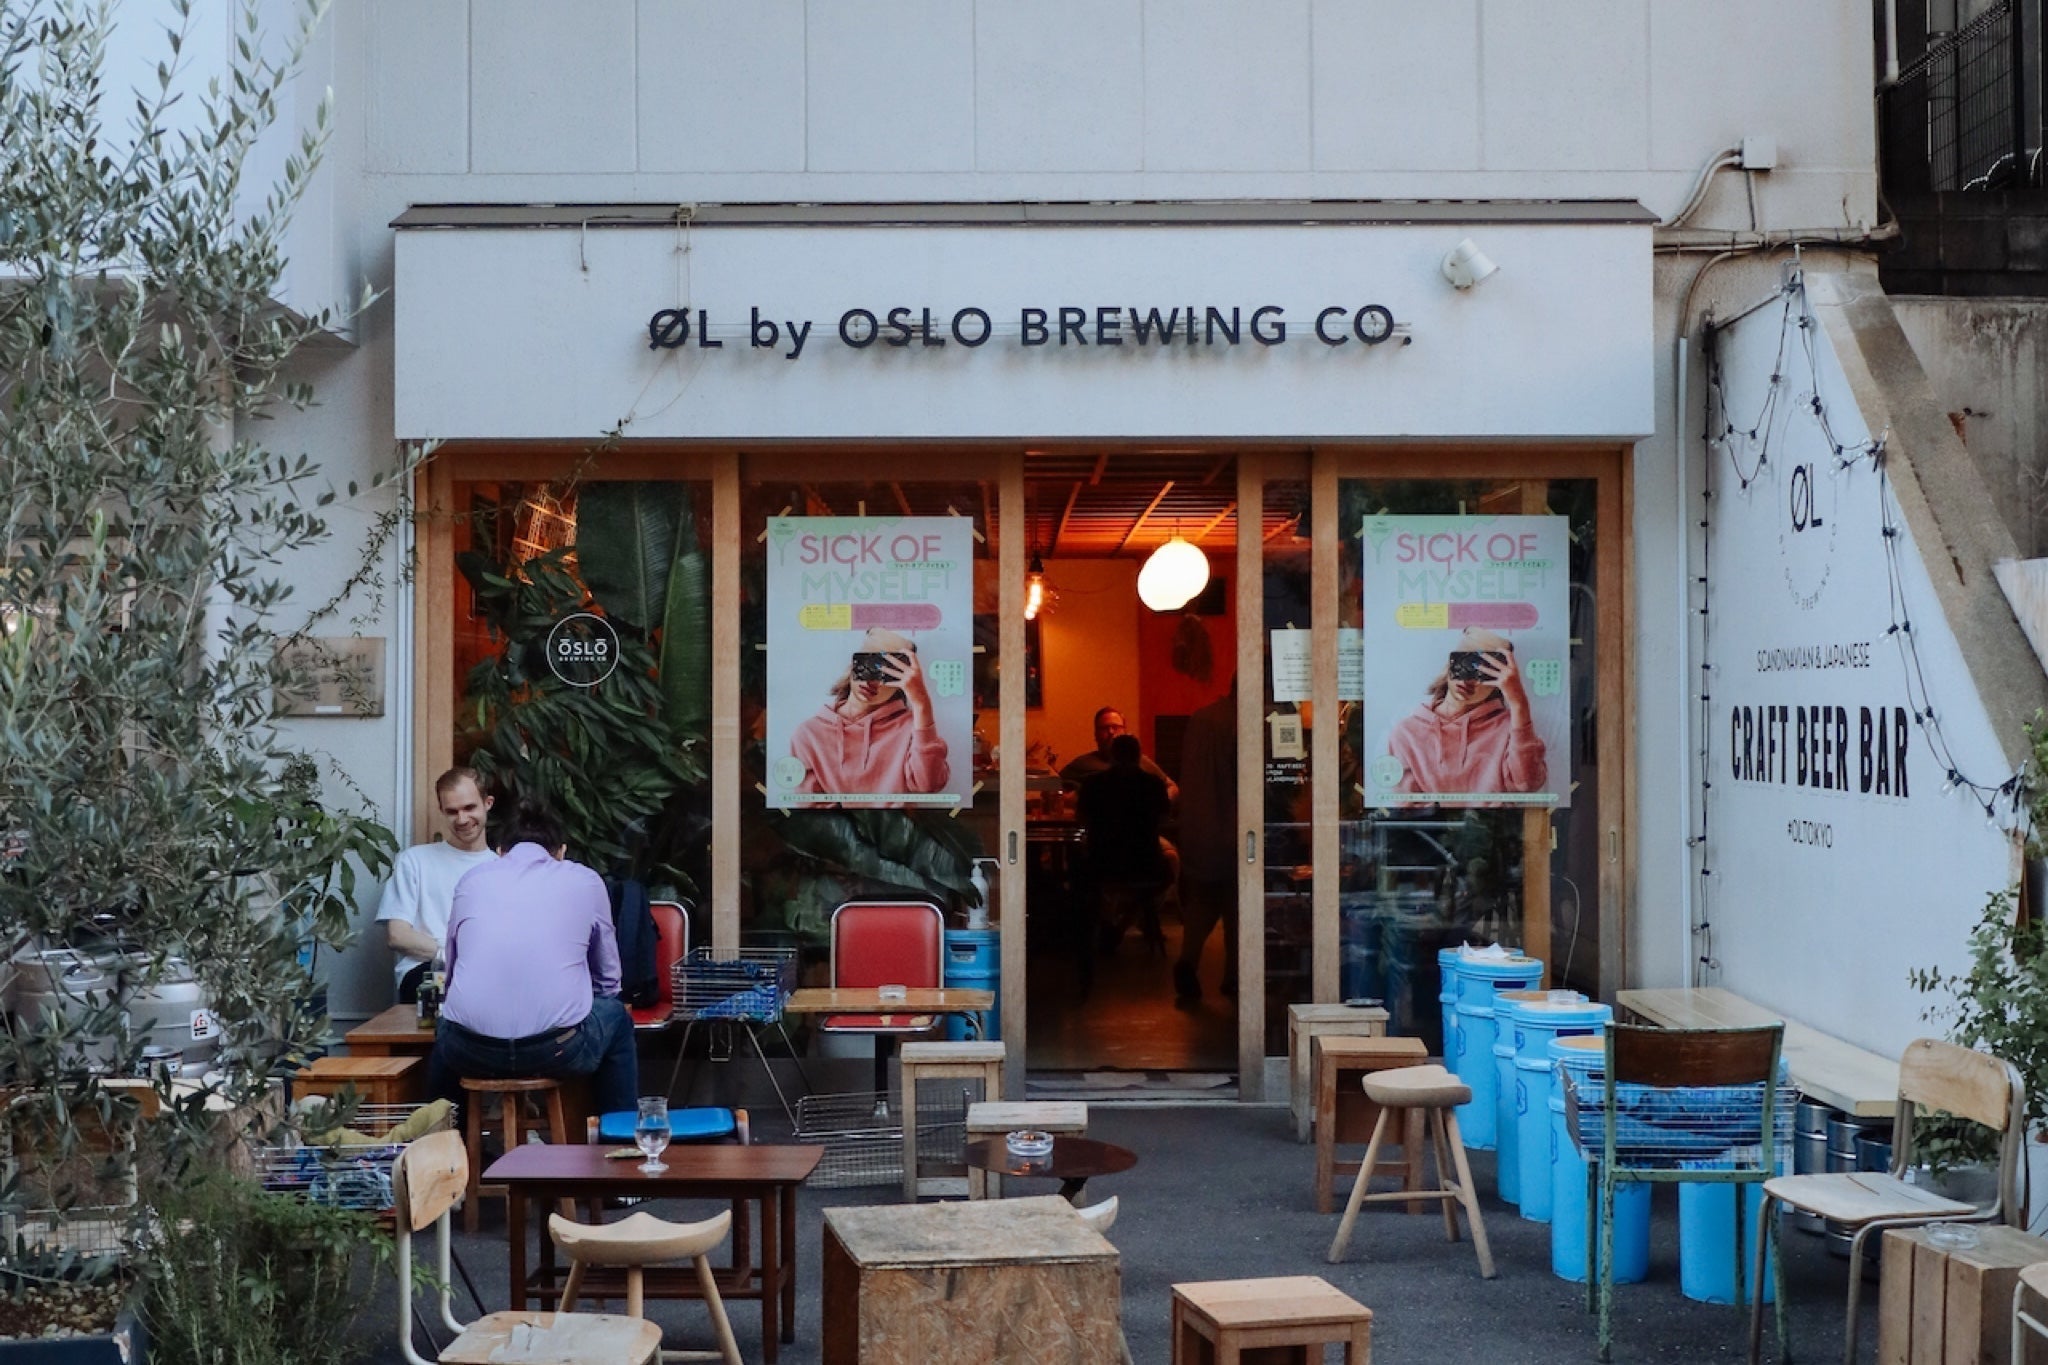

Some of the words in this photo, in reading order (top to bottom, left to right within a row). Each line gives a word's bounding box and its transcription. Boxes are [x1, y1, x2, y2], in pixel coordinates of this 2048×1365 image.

[648, 307, 723, 350] ØL
[750, 306, 812, 360] by
[838, 307, 992, 348] OSLO
[1021, 305, 1286, 346] BREWING
[1790, 463, 1823, 534] ØL
[799, 534, 883, 564] SICK
[890, 534, 942, 563] OF
[1396, 532, 1479, 562] SICK
[1486, 533, 1538, 562] OF
[802, 570, 944, 600] MYSELF
[1398, 568, 1540, 600] MYSELF
[1823, 642, 1869, 669] JAPANESE
[1731, 705, 1789, 784] CRAFT
[1796, 705, 1849, 792] BEER
[1860, 706, 1910, 798] BAR
